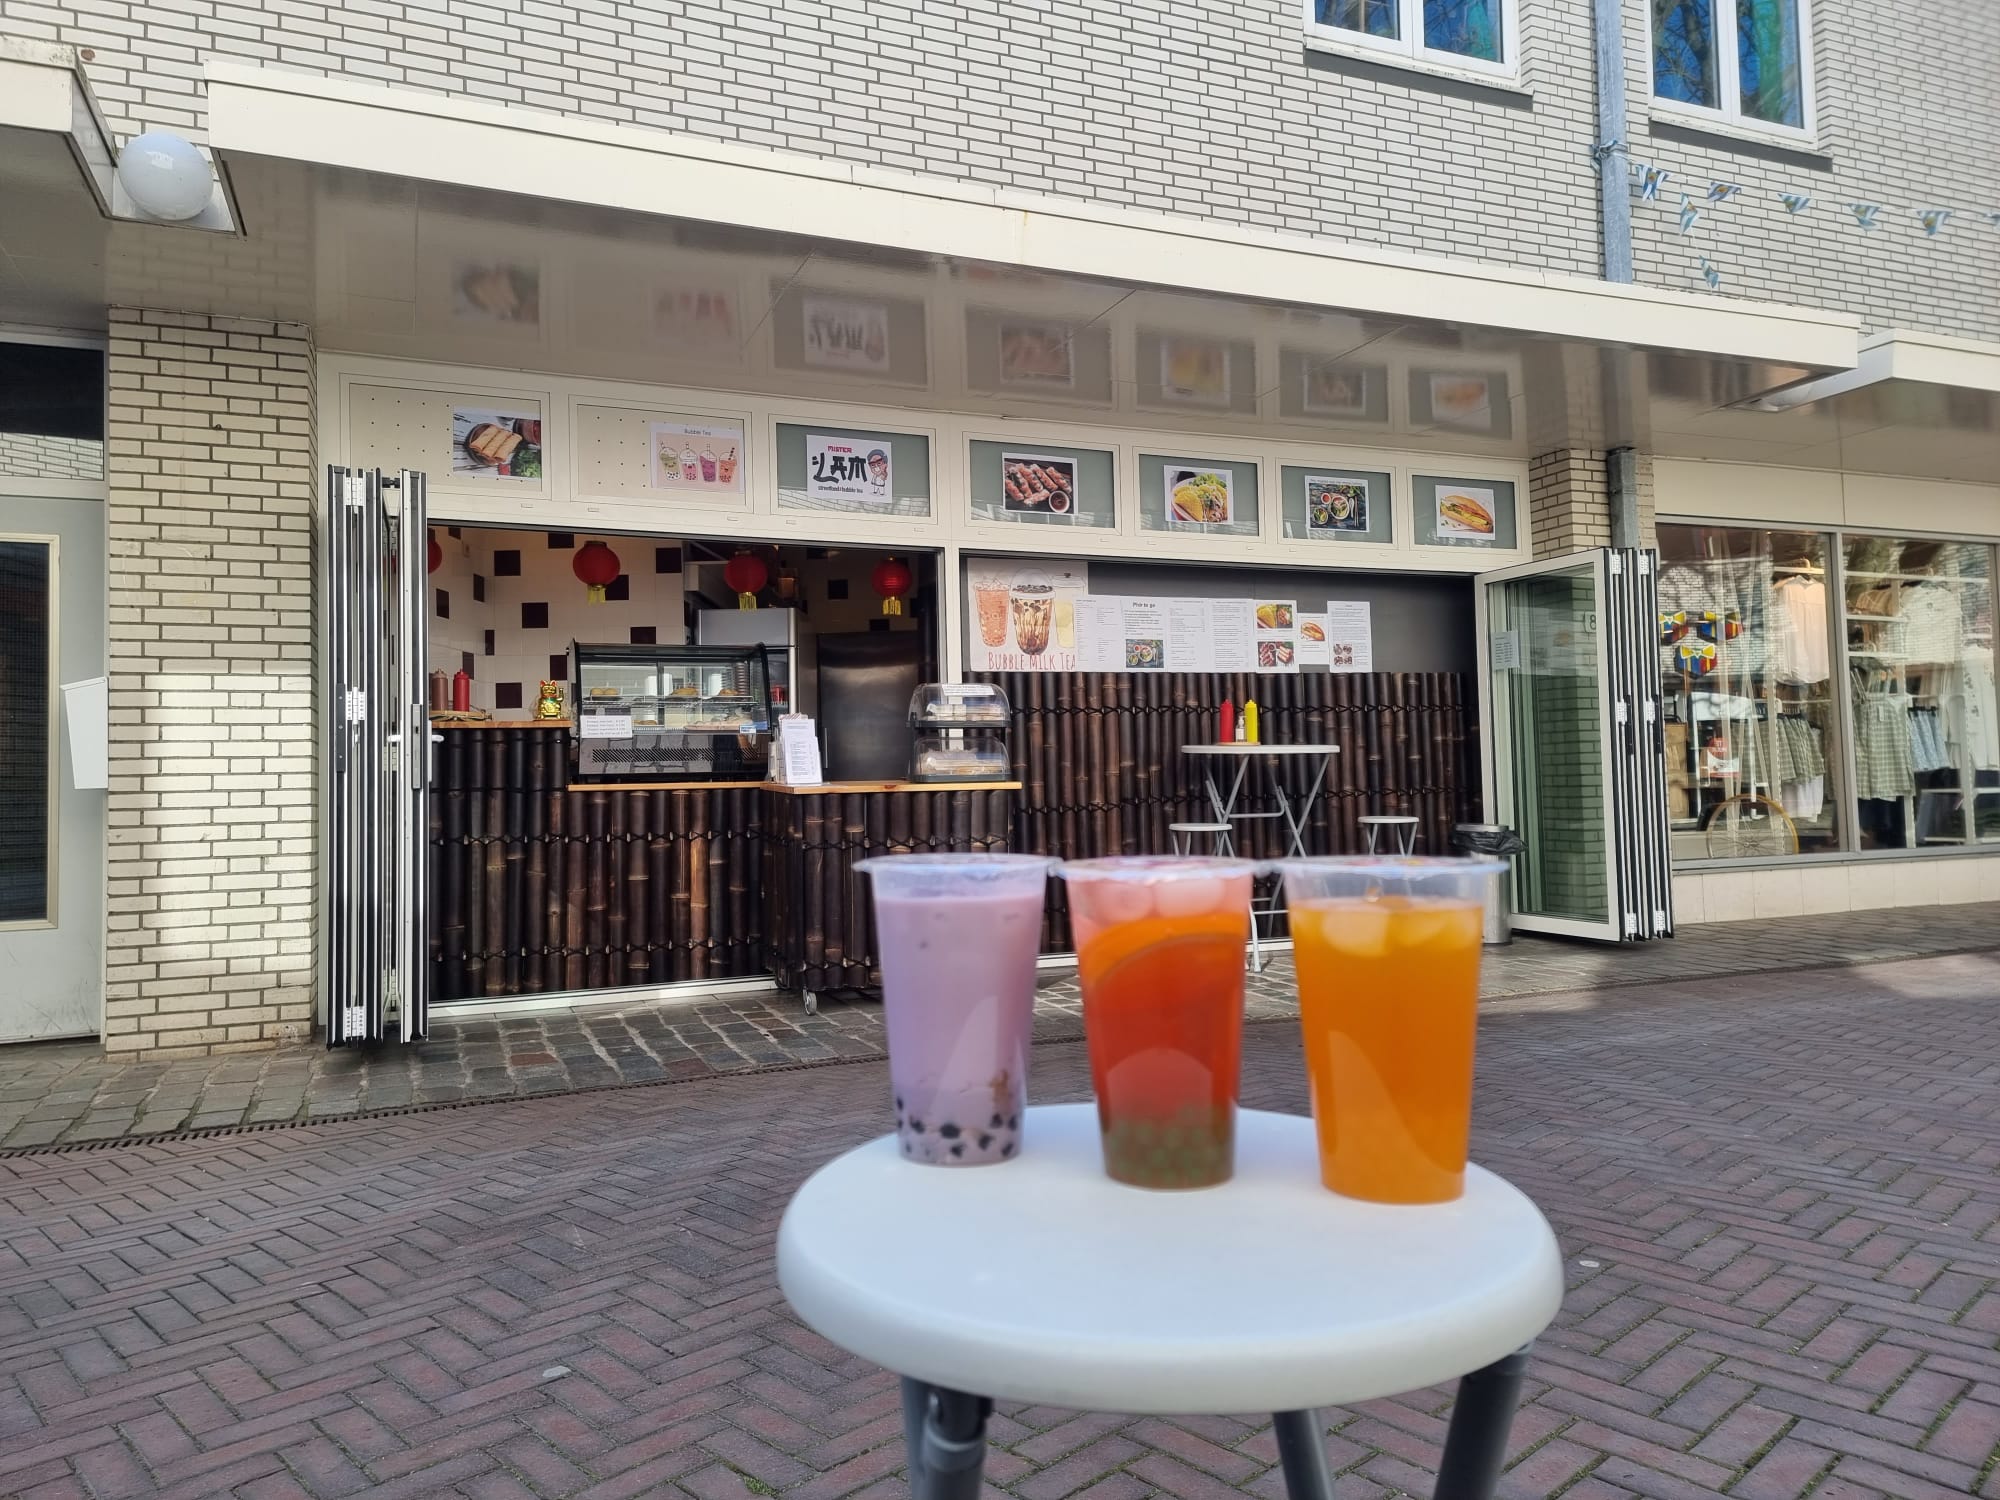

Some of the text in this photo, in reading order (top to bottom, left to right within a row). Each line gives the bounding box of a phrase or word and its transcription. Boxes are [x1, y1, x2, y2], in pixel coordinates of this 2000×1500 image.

[812, 452, 867, 484] LAM
[988, 651, 1076, 671] BUBBLE MILK TEA
